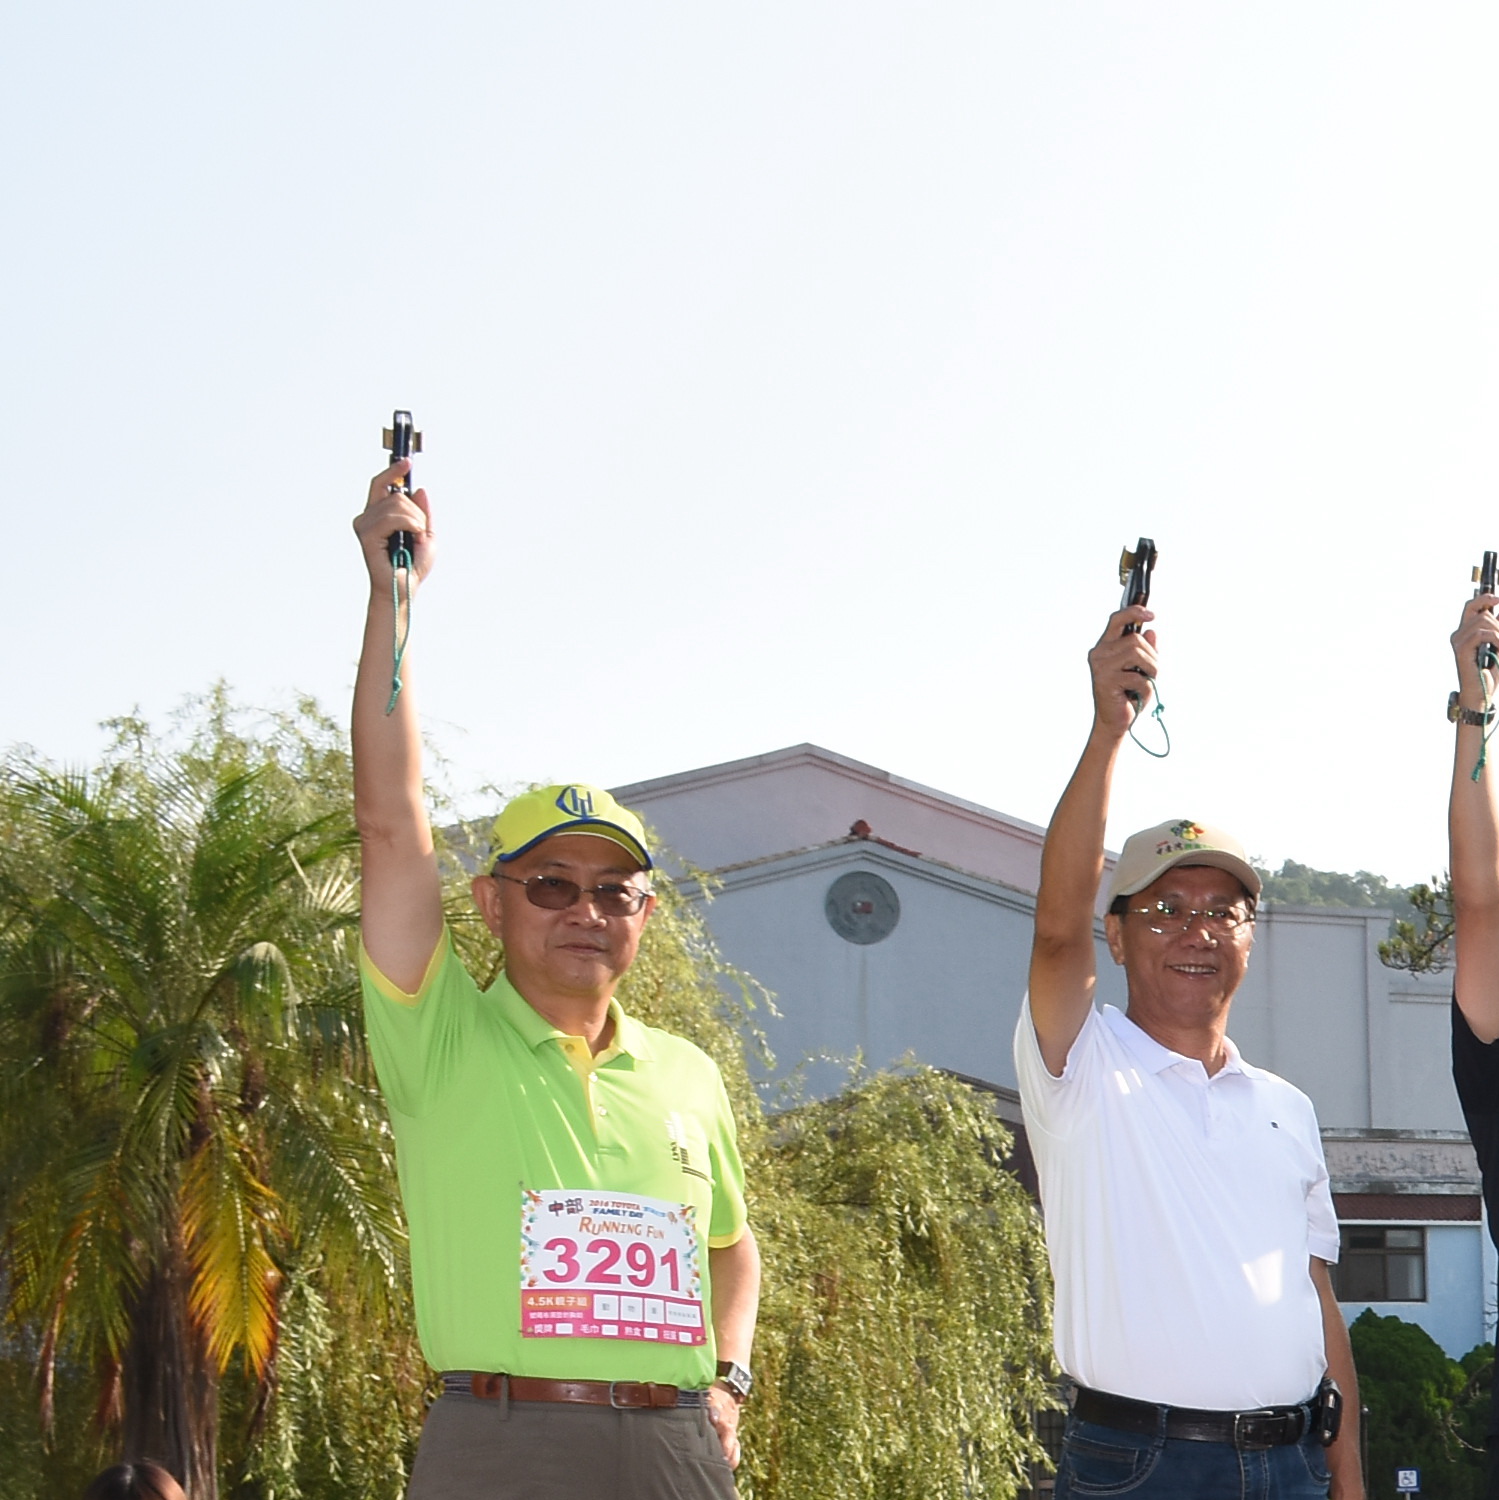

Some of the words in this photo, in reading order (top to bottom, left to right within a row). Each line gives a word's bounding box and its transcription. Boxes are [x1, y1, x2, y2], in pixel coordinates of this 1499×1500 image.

[548, 1198, 584, 1217] 中部
[589, 1199, 609, 1207] 2016
[611, 1201, 641, 1210] TOYOTA
[592, 1207, 627, 1217] FAMILY
[628, 1209, 645, 1218] DAY
[579, 1216, 642, 1236] RUNNING
[646, 1225, 665, 1239] FUN
[543, 1237, 680, 1292] 3291
